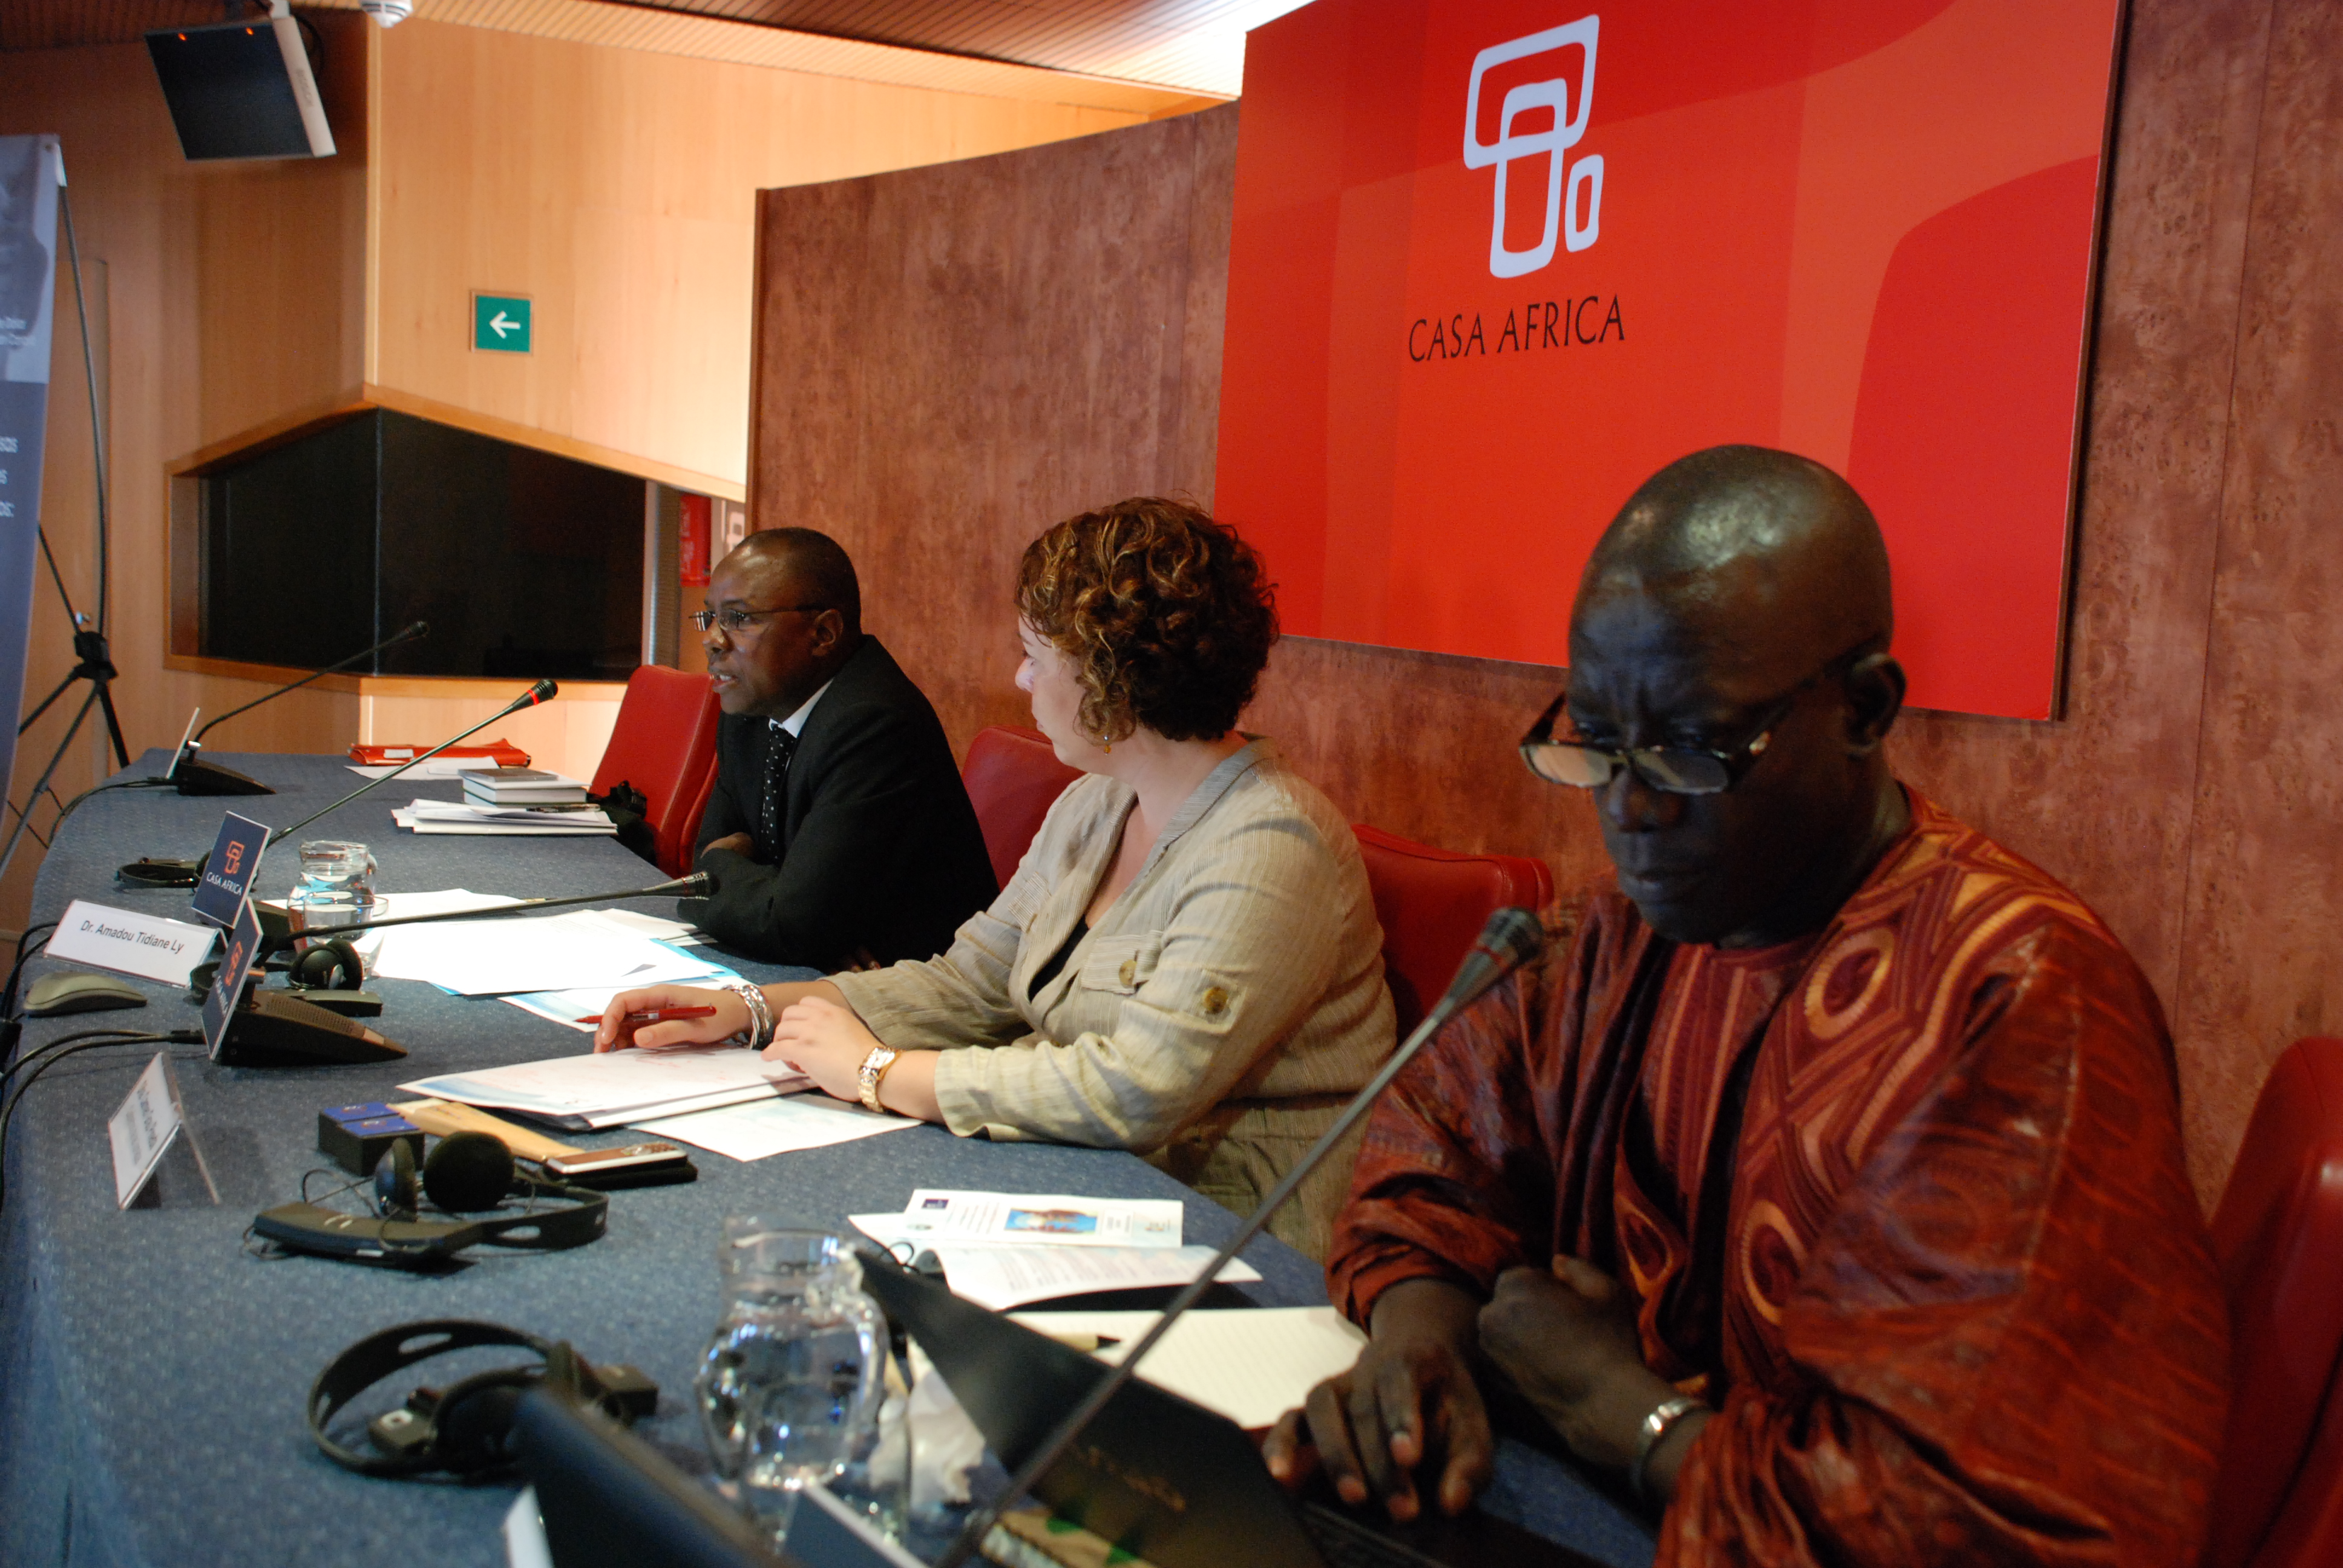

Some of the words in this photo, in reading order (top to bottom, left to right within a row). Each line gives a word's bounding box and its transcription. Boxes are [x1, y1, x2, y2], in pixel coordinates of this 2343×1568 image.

[1409, 312, 1486, 362] CASA
[1496, 293, 1625, 353] AFRICA
[206, 872, 222, 886] CASA
[221, 879, 243, 895] AFRICA
[80, 920, 93, 932] Dr.
[96, 924, 135, 941] Amadou
[136, 932, 170, 949] Tidiane
[171, 939, 185, 954] Ly
